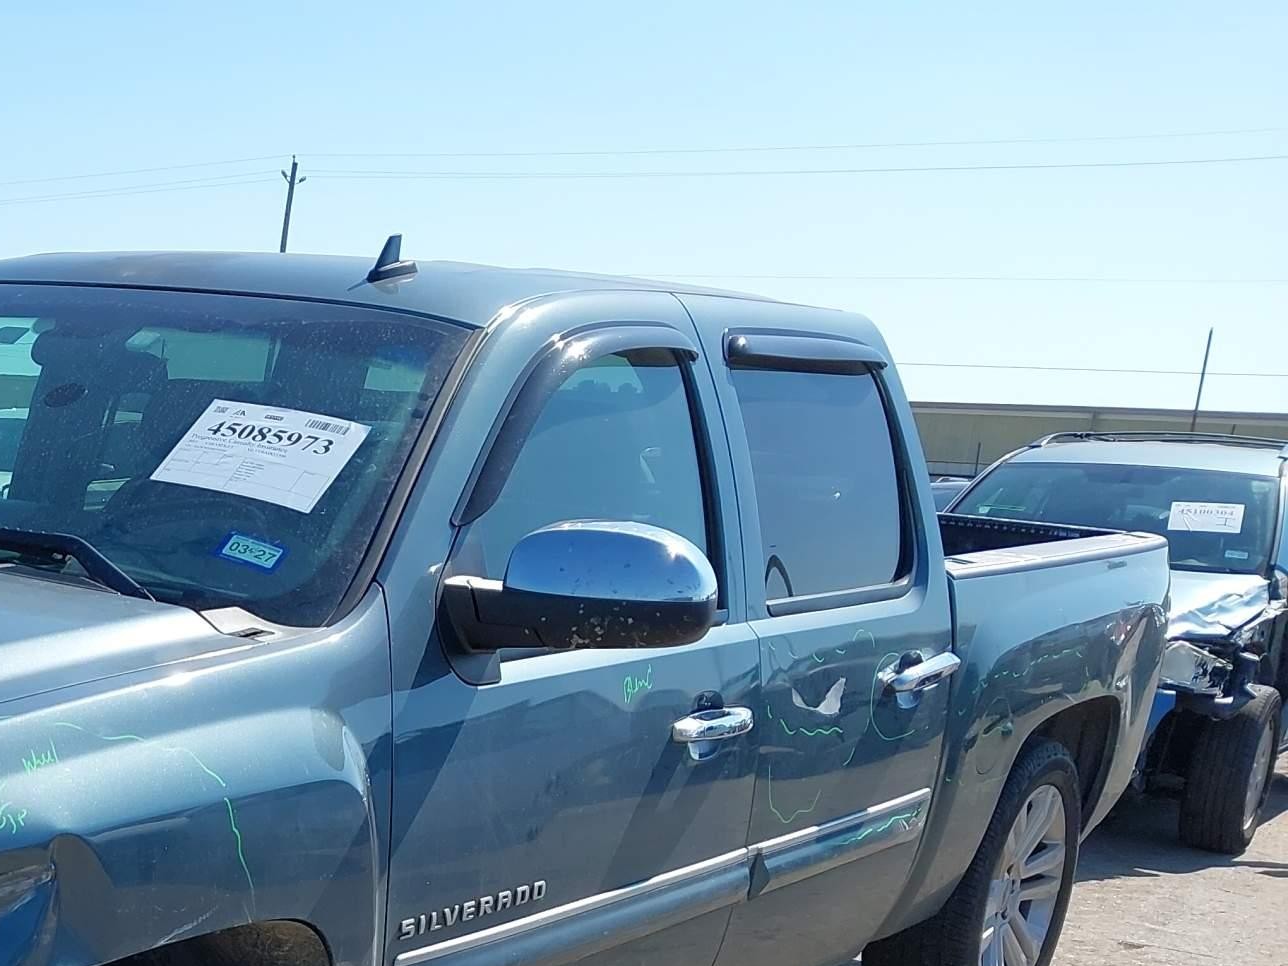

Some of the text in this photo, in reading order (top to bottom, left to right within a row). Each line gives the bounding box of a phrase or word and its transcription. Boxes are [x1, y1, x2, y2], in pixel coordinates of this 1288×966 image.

[207, 420, 335, 455] 45085973
[229, 541, 276, 562] 03 27
[399, 879, 547, 941] SILVERADO
